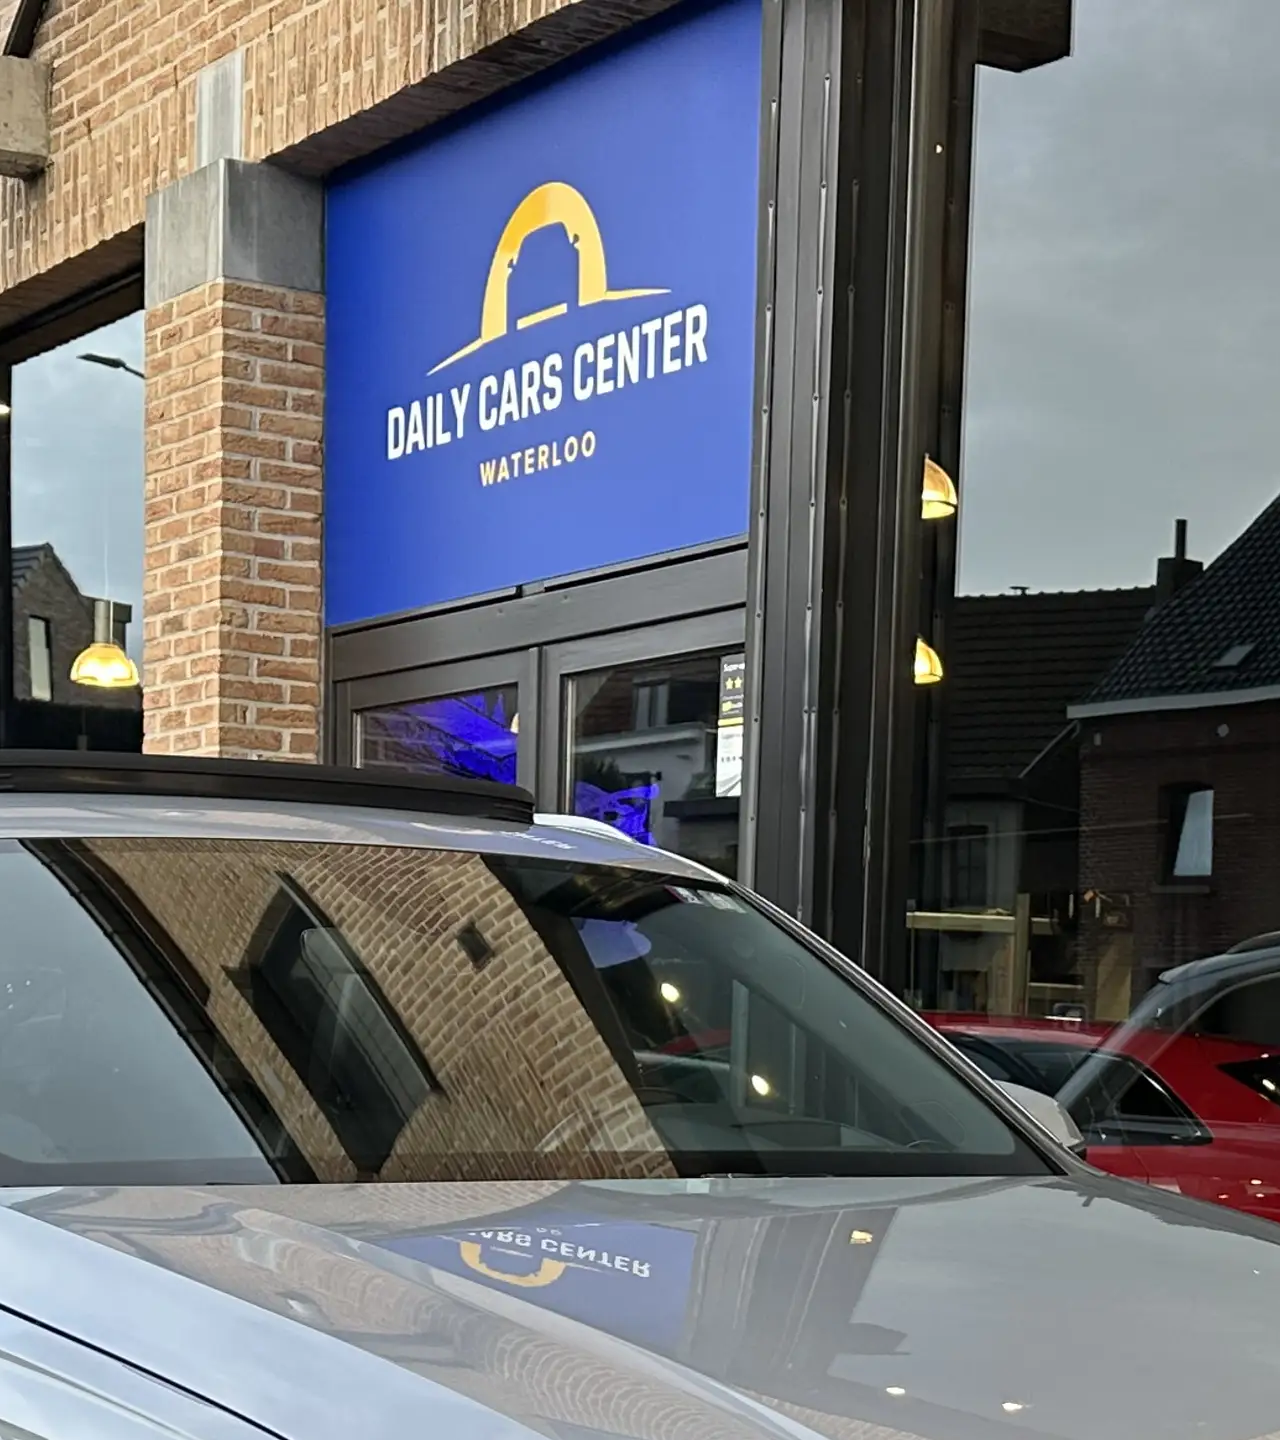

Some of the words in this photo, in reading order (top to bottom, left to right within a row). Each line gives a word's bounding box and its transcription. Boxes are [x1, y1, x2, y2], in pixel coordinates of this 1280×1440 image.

[387, 382, 470, 459] DAILY
[478, 351, 563, 431] CARS
[573, 303, 709, 402] CENTER
[479, 430, 596, 488] WATERLOO
